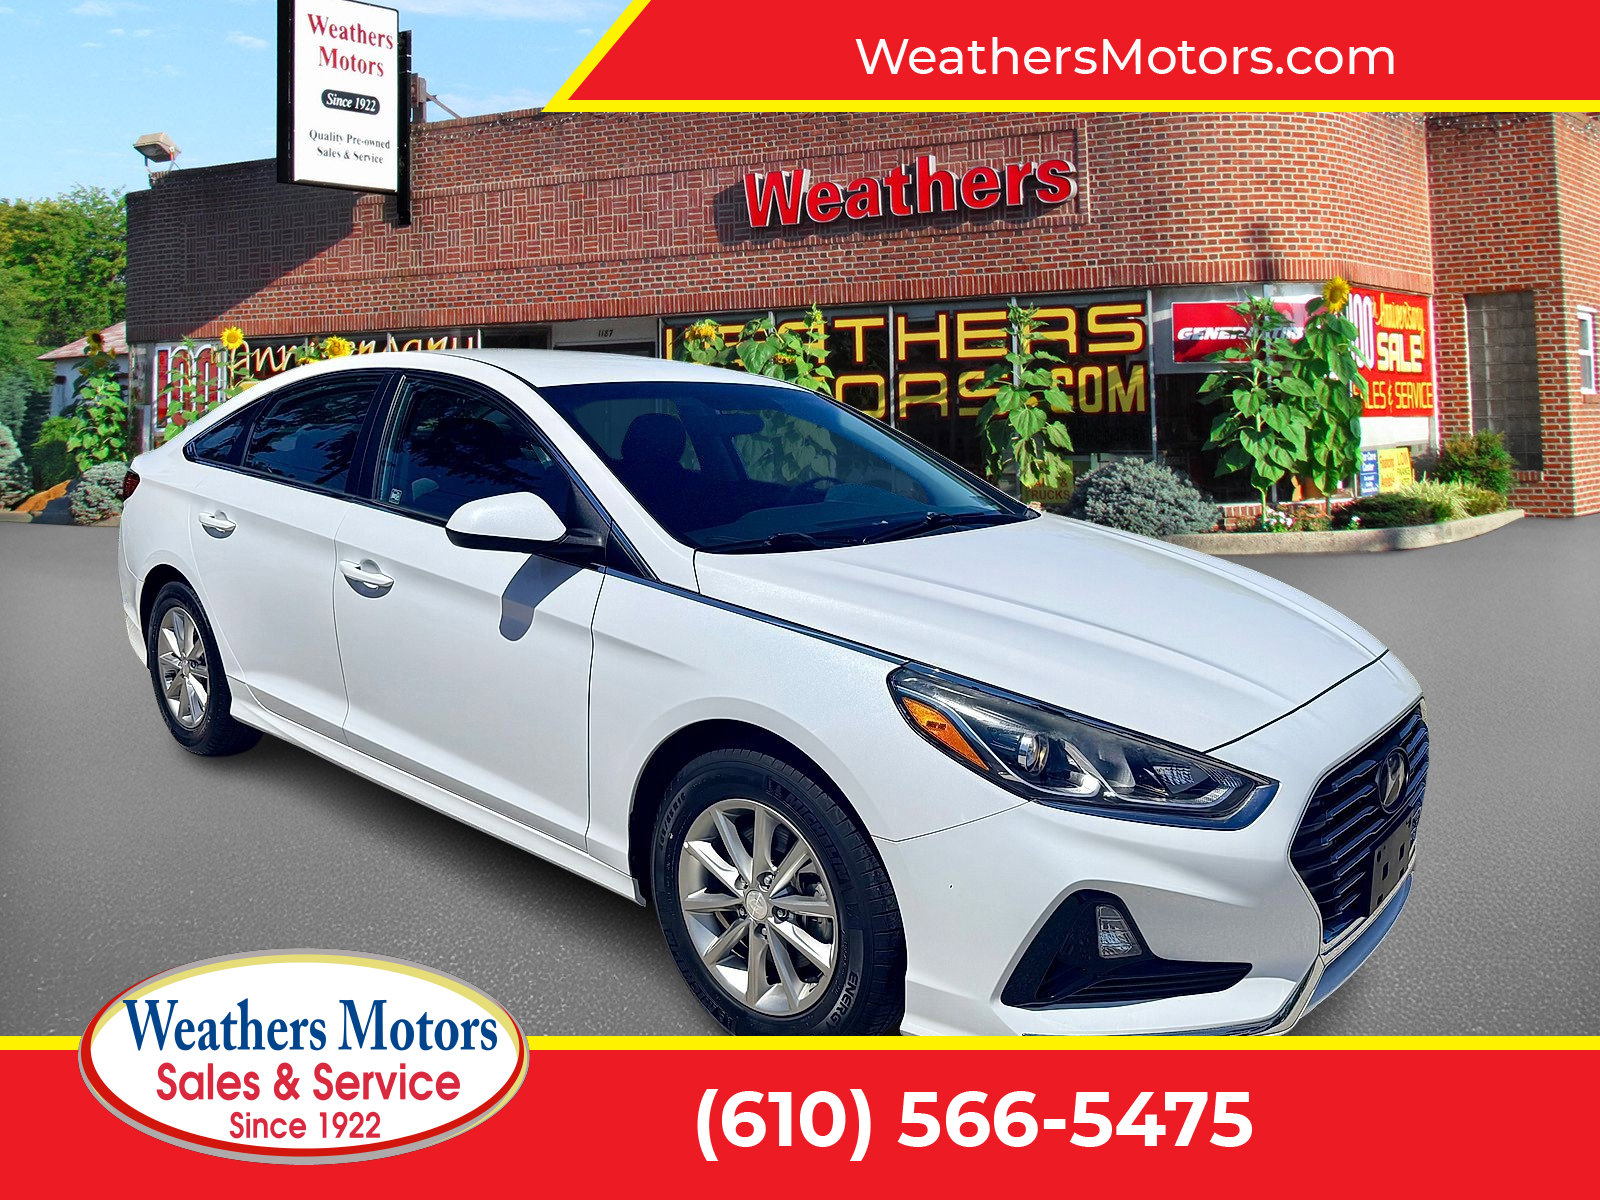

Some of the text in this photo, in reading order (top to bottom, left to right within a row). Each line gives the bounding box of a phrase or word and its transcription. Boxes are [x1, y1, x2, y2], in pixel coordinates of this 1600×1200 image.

[307, 13, 394, 50] Weathers
[318, 45, 385, 78] Motors
[326, 92, 377, 112] Since 1922
[309, 129, 391, 150] Quality Pre-owned
[317, 146, 384, 164] Sales & Service
[743, 154, 1078, 228] Weathers
[598, 329, 614, 338] 1187
[1376, 332, 1423, 374] SALE
[1395, 381, 1434, 409] SERVICE
